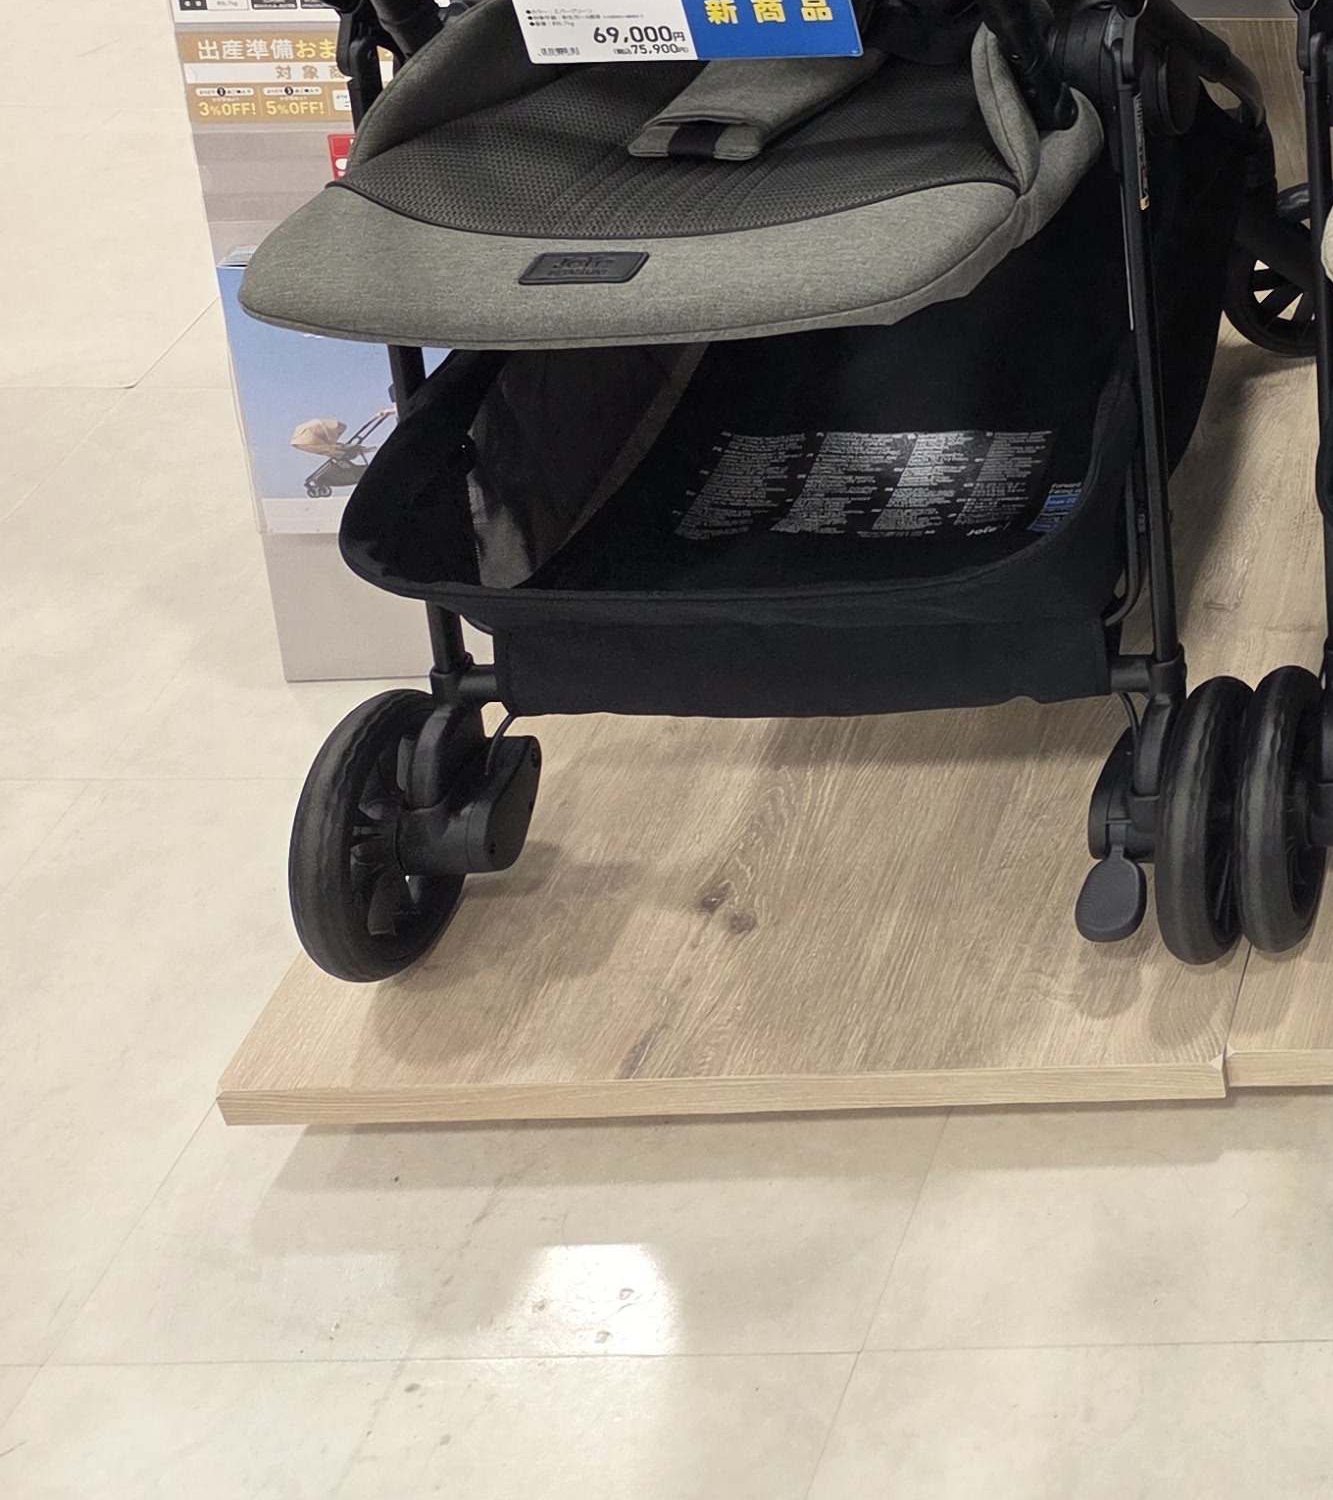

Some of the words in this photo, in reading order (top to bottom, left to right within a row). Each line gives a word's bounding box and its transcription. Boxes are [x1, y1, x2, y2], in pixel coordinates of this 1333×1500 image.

[593, 25, 686, 44] 69,000円
[199, 101, 257, 117] 3%OFF!
[266, 100, 325, 115] 5%OFF!
